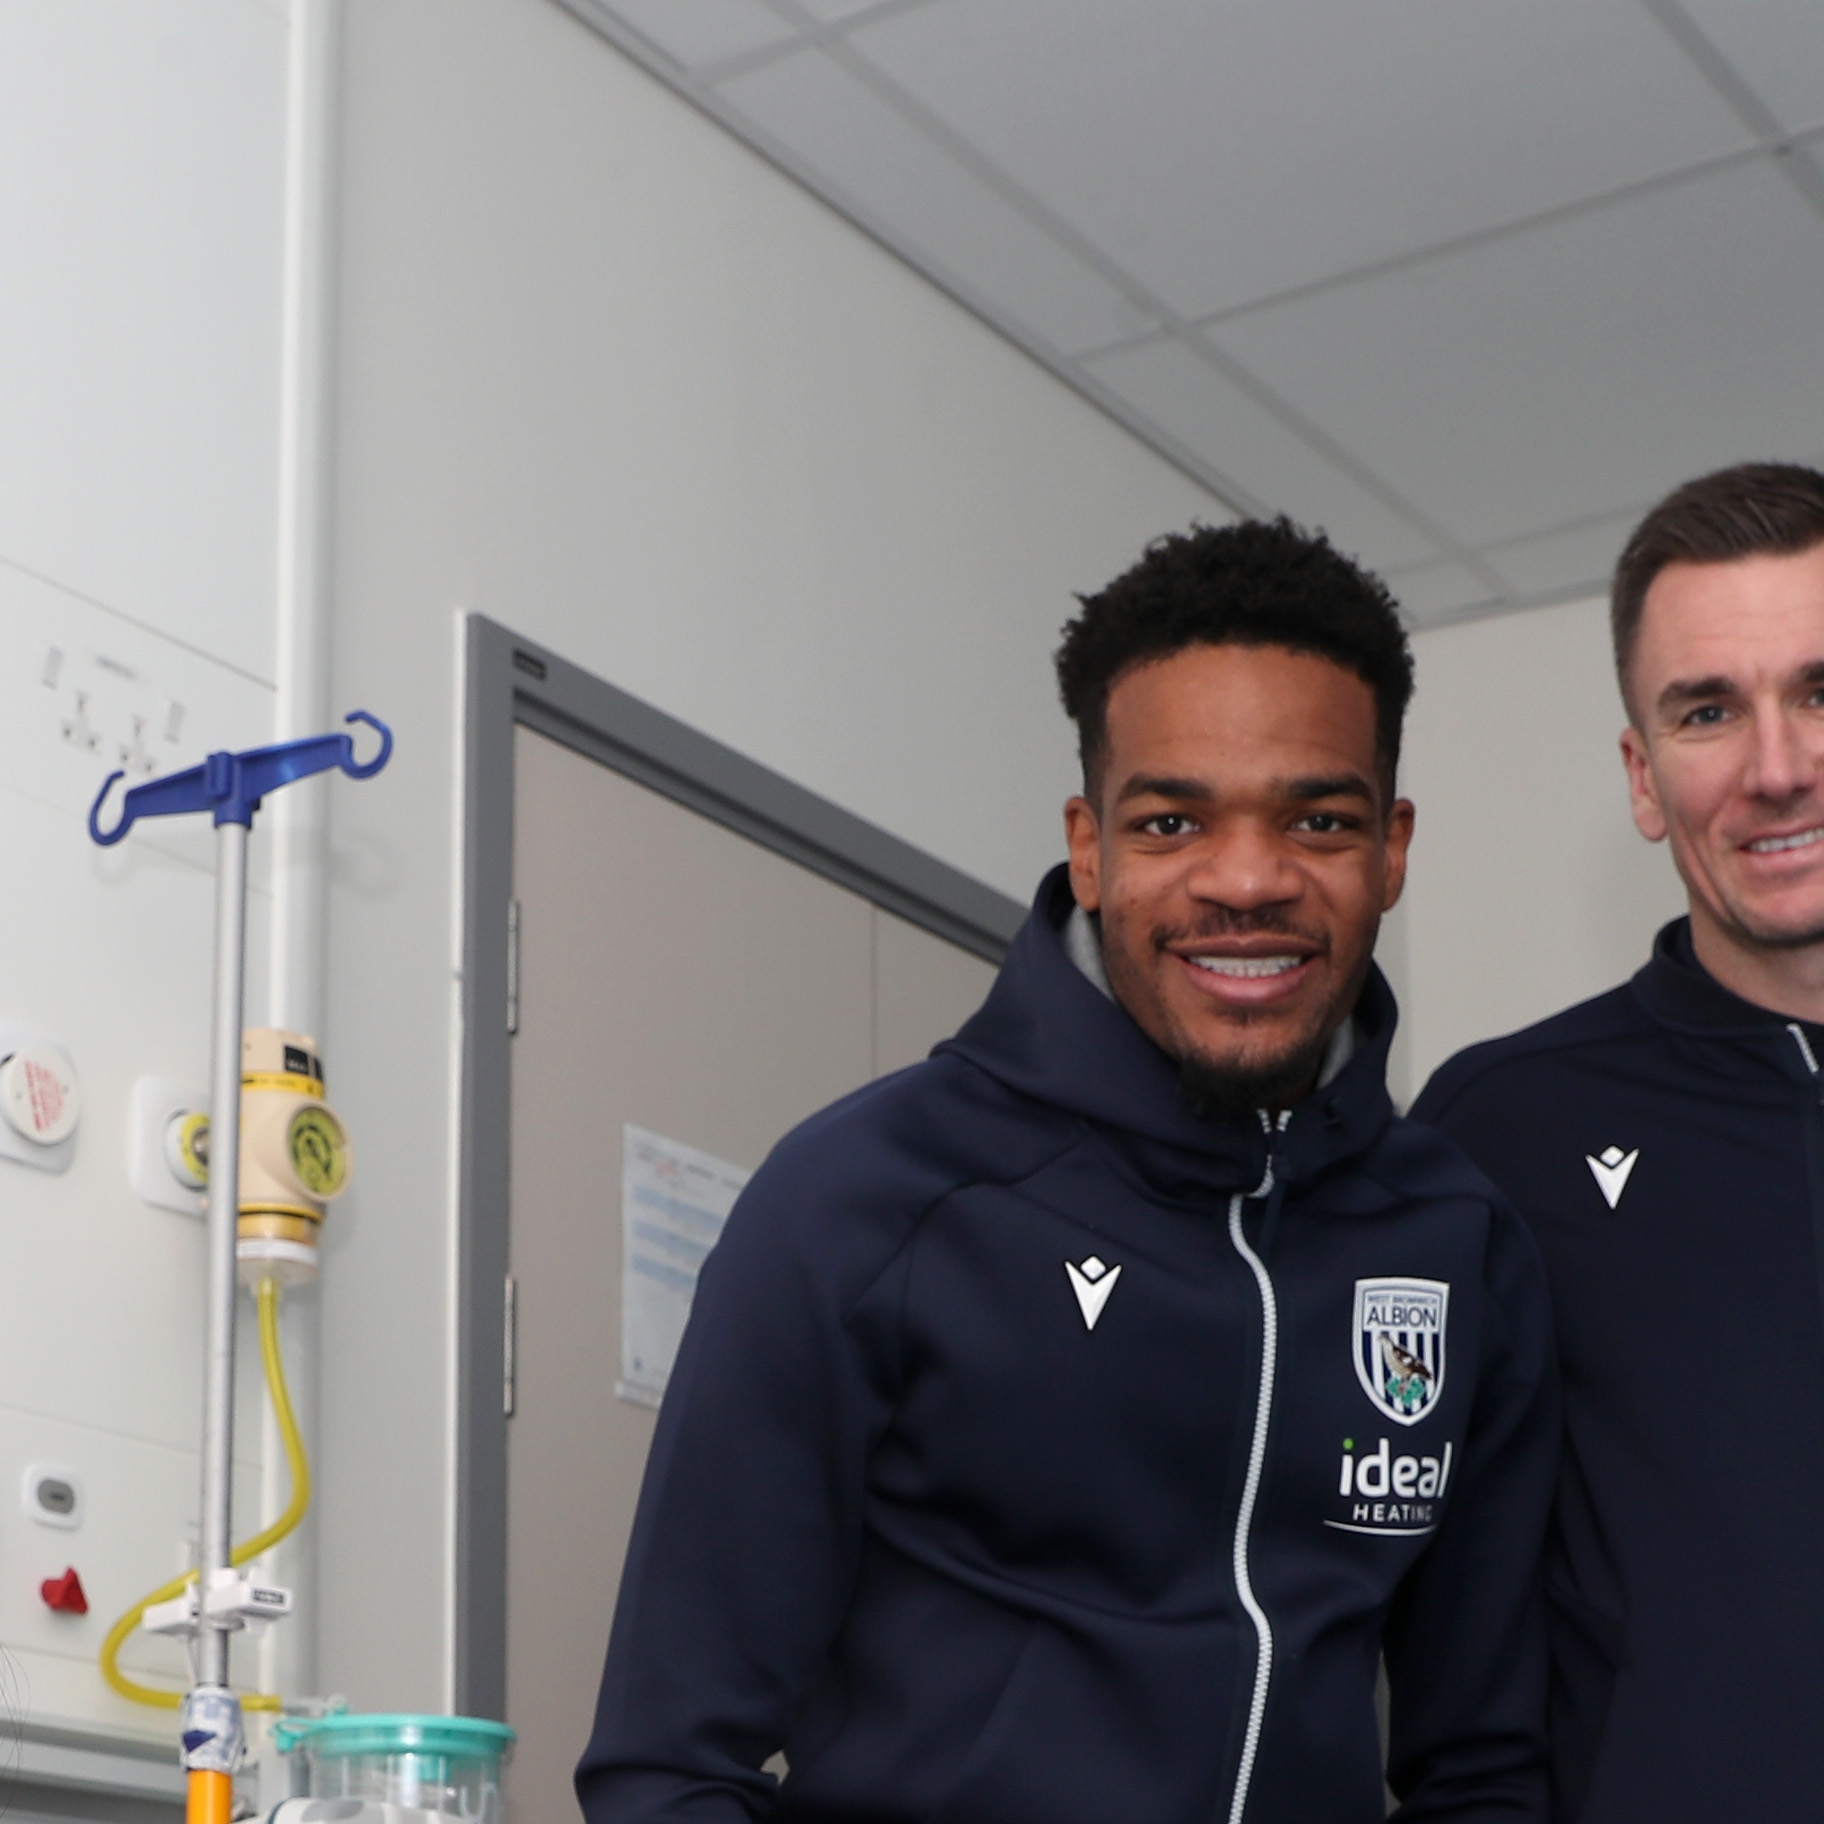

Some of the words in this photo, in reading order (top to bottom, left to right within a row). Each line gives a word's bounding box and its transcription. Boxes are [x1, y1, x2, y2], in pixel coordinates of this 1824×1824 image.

[1367, 1305, 1437, 1327] ALBION
[1339, 1437, 1453, 1499] ideal
[1352, 1503, 1433, 1523] HEATING
